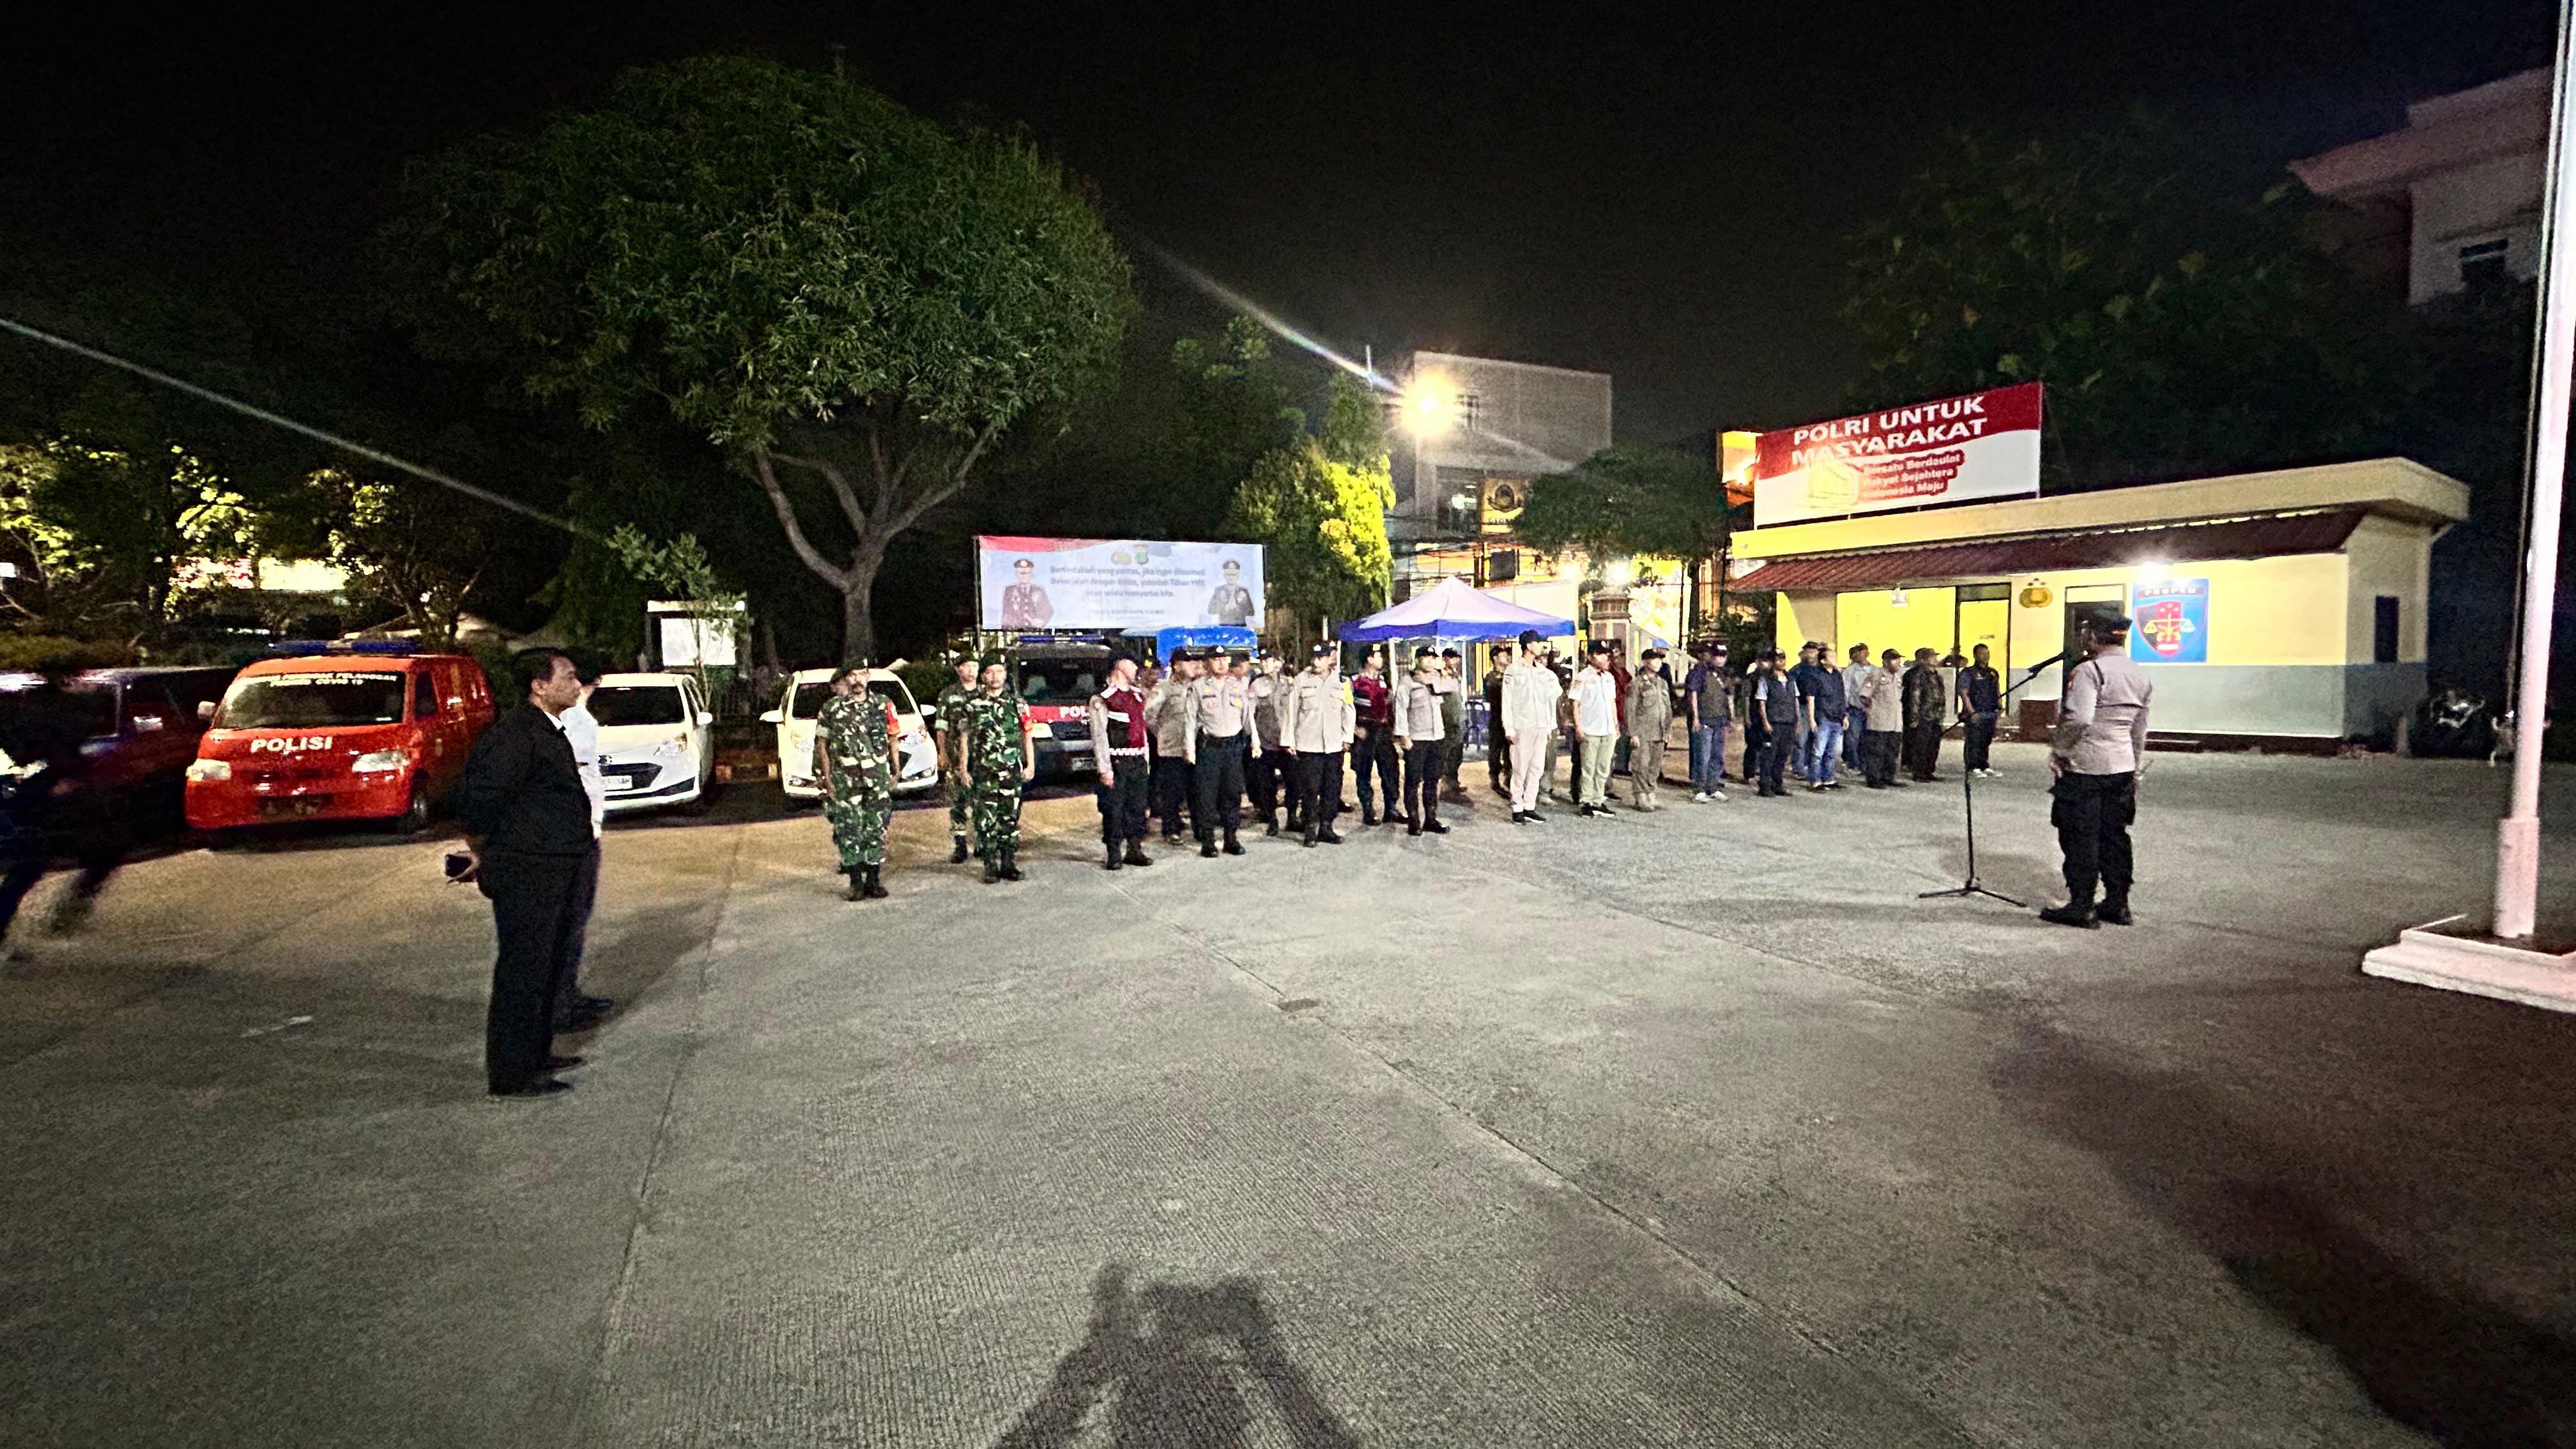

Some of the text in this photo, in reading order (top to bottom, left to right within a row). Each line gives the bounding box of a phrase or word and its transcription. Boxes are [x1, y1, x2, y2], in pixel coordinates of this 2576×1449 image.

[1793, 396, 1985, 446] POLRI UNTUK
[1791, 418, 1988, 466] MASYARAKAT
[1906, 454, 1961, 470] Berdaulat
[1901, 468, 1954, 483] Sejahtera
[1917, 481, 1945, 493] Maju
[250, 736, 334, 754] POLISI
